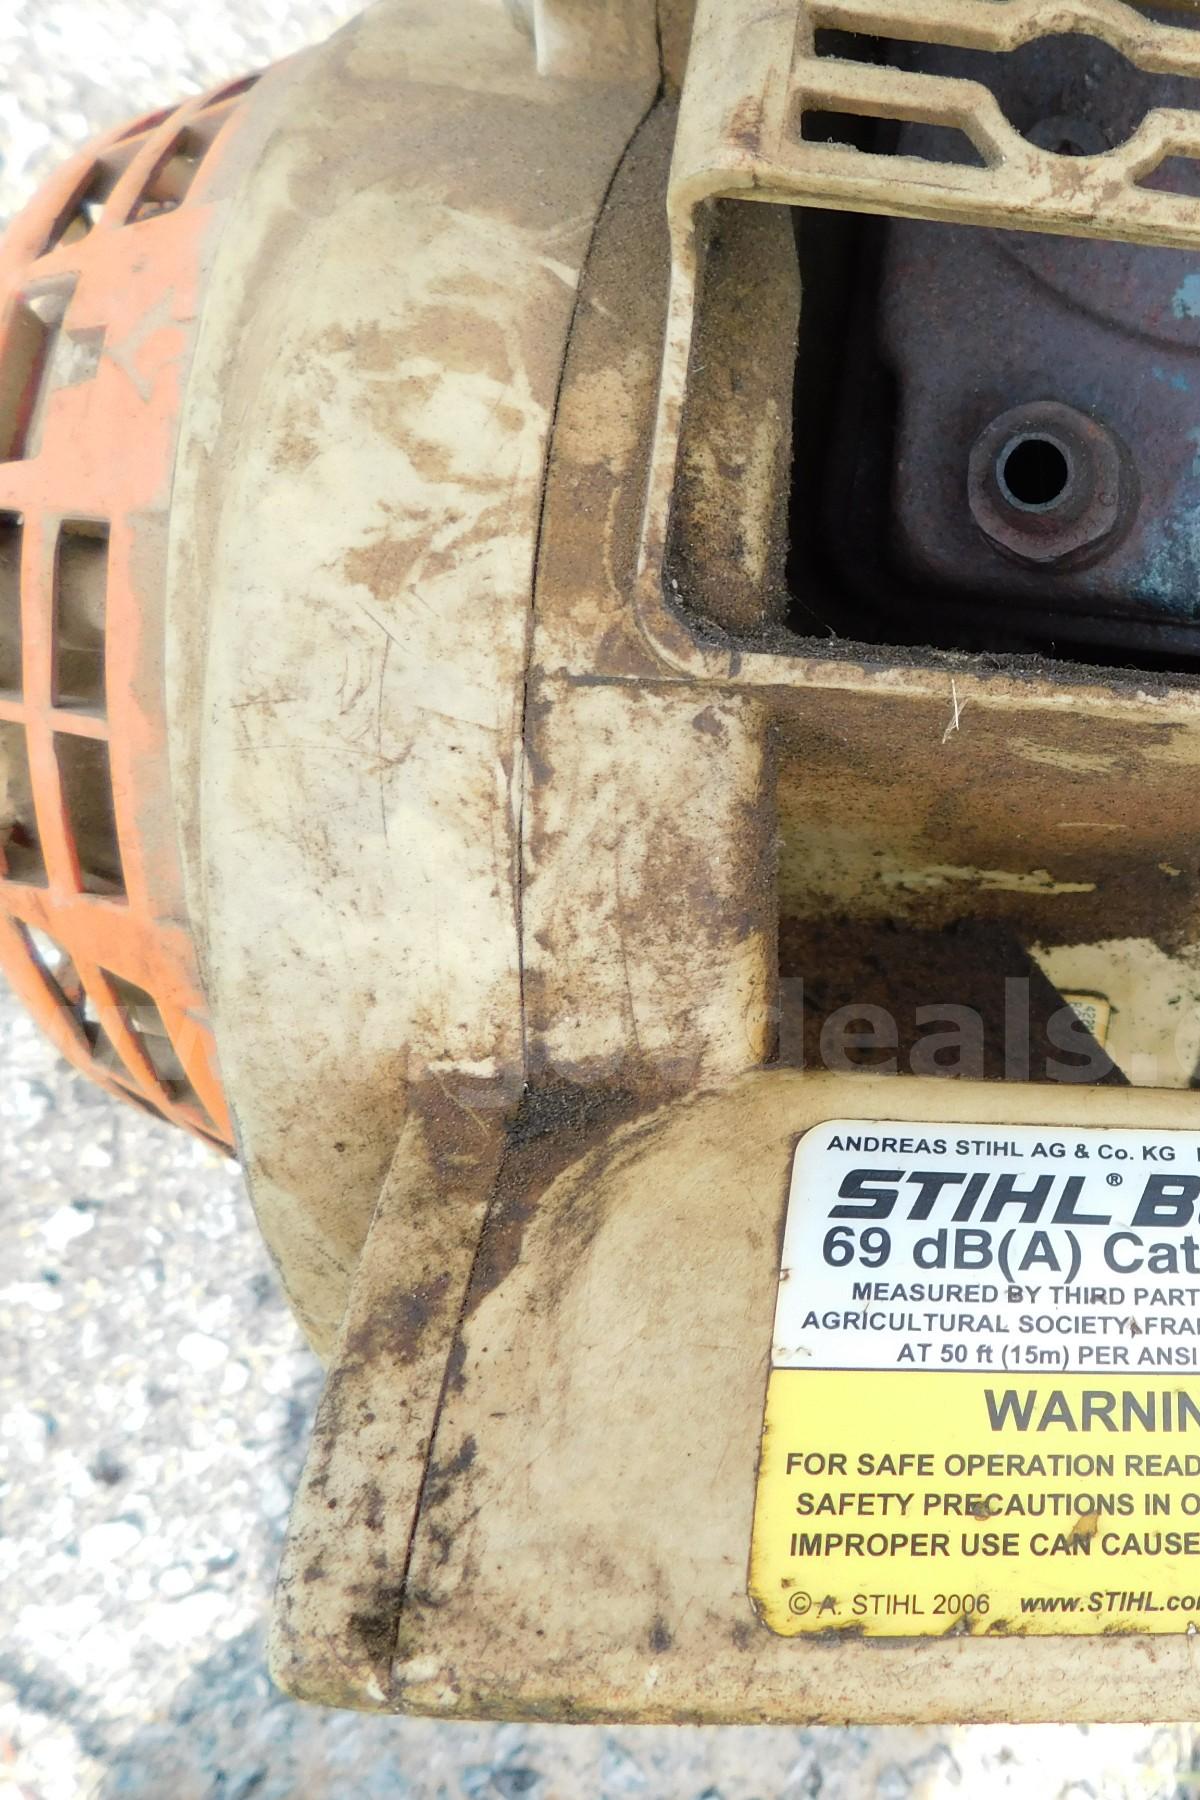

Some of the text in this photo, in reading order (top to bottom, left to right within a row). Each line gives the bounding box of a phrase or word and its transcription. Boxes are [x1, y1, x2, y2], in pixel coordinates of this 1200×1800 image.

[827, 1135, 950, 1156] ANDREAS
[955, 1137, 1025, 1158] STIHL
[1030, 1140, 1068, 1159] AG
[1074, 1142, 1090, 1161] &
[1097, 1143, 1135, 1161] Co.
[1142, 1144, 1176, 1162] KG
[822, 1226, 893, 1270] 69
[914, 1229, 1083, 1284] dB(A)
[852, 1282, 1000, 1304] MEASURED
[1004, 1283, 1044, 1305] BY
[1050, 1285, 1127, 1306] THIRD
[801, 1311, 1009, 1334] AGRICULTURAL
[897, 1343, 935, 1364] AT
[940, 1345, 972, 1365] 50
[976, 1344, 993, 1365] ft
[1002, 1345, 1070, 1371] (15m)
[1078, 1346, 1131, 1367] PER
[1137, 1346, 1198, 1367] ANSI
[786, 1453, 850, 1475] FOR
[856, 1453, 935, 1476] SAFE
[944, 1455, 1120, 1478] OPERATION
[796, 1493, 914, 1517] SAFETY
[923, 1493, 1135, 1517] PRECAUTIONS
[1145, 1493, 1172, 1516] IN
[790, 1533, 951, 1558] IMPROPER
[960, 1533, 1020, 1558] USE
[1029, 1533, 1092, 1558] CAN
[1101, 1532, 1200, 1557] CAUSE
[816, 1594, 842, 1616] A.
[851, 1594, 925, 1616] STIHL
[932, 1594, 991, 1616] 2006
